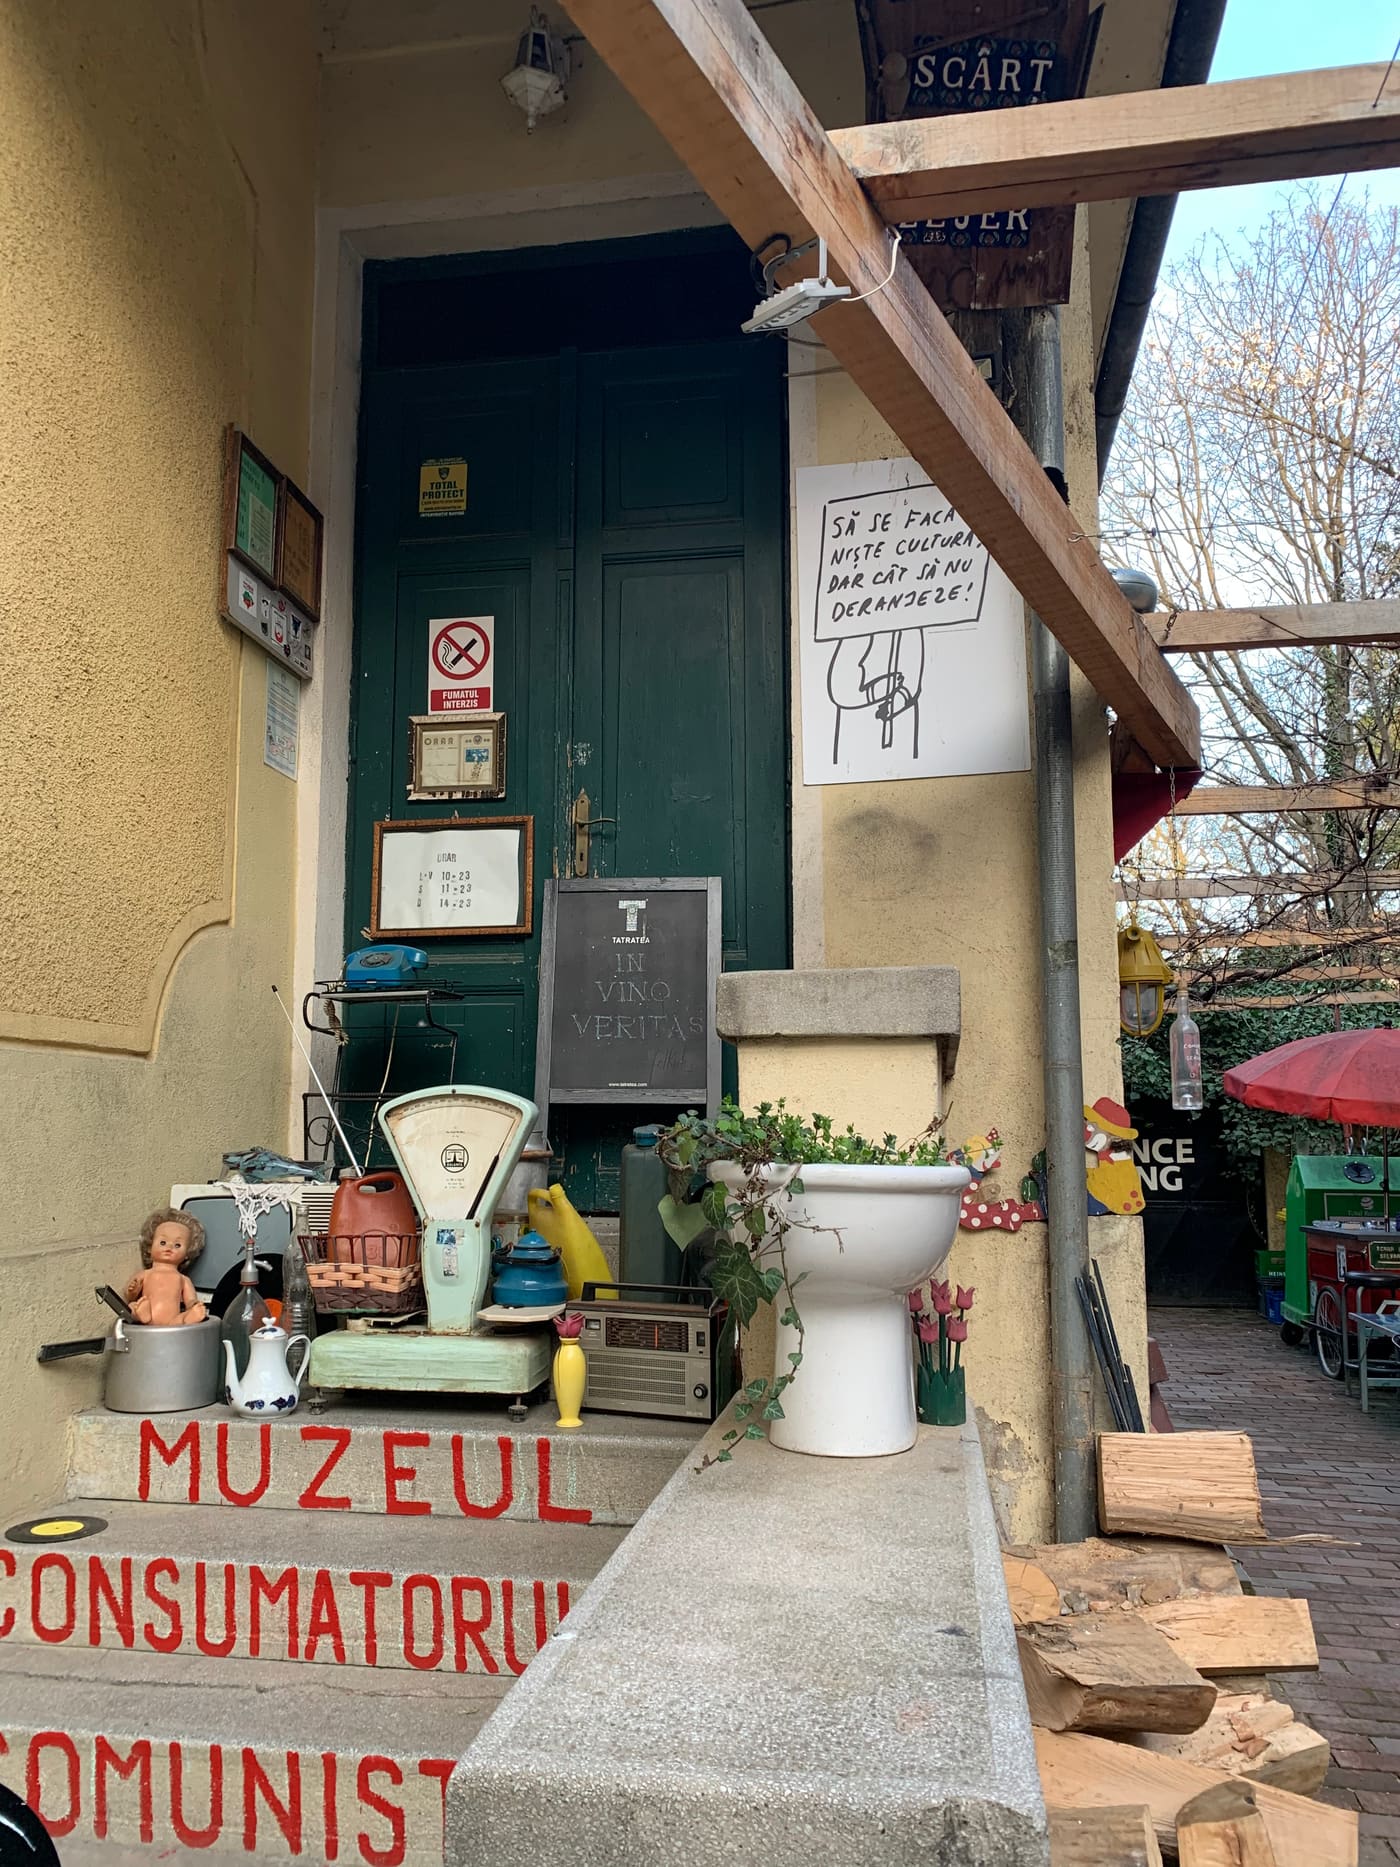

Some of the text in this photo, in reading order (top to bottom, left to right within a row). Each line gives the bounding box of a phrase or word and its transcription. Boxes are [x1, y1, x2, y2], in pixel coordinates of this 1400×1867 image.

[422, 489, 464, 499] PROTECT
[430, 481, 458, 490] TOTAL
[868, 512, 892, 533] SE
[827, 573, 864, 594] DAR
[944, 558, 973, 577] NU
[832, 582, 974, 622] DERANJEZE!
[442, 690, 479, 700] FUMATUL
[443, 699, 478, 709] INTERZIS
[612, 937, 650, 945] TATRATEA
[615, 953, 645, 973] IN
[595, 981, 671, 1002] VINO
[571, 1013, 704, 1041] VERITAS
[138, 1419, 592, 1524] MUZEUL
[0, 1731, 459, 1867] OMUNIST
